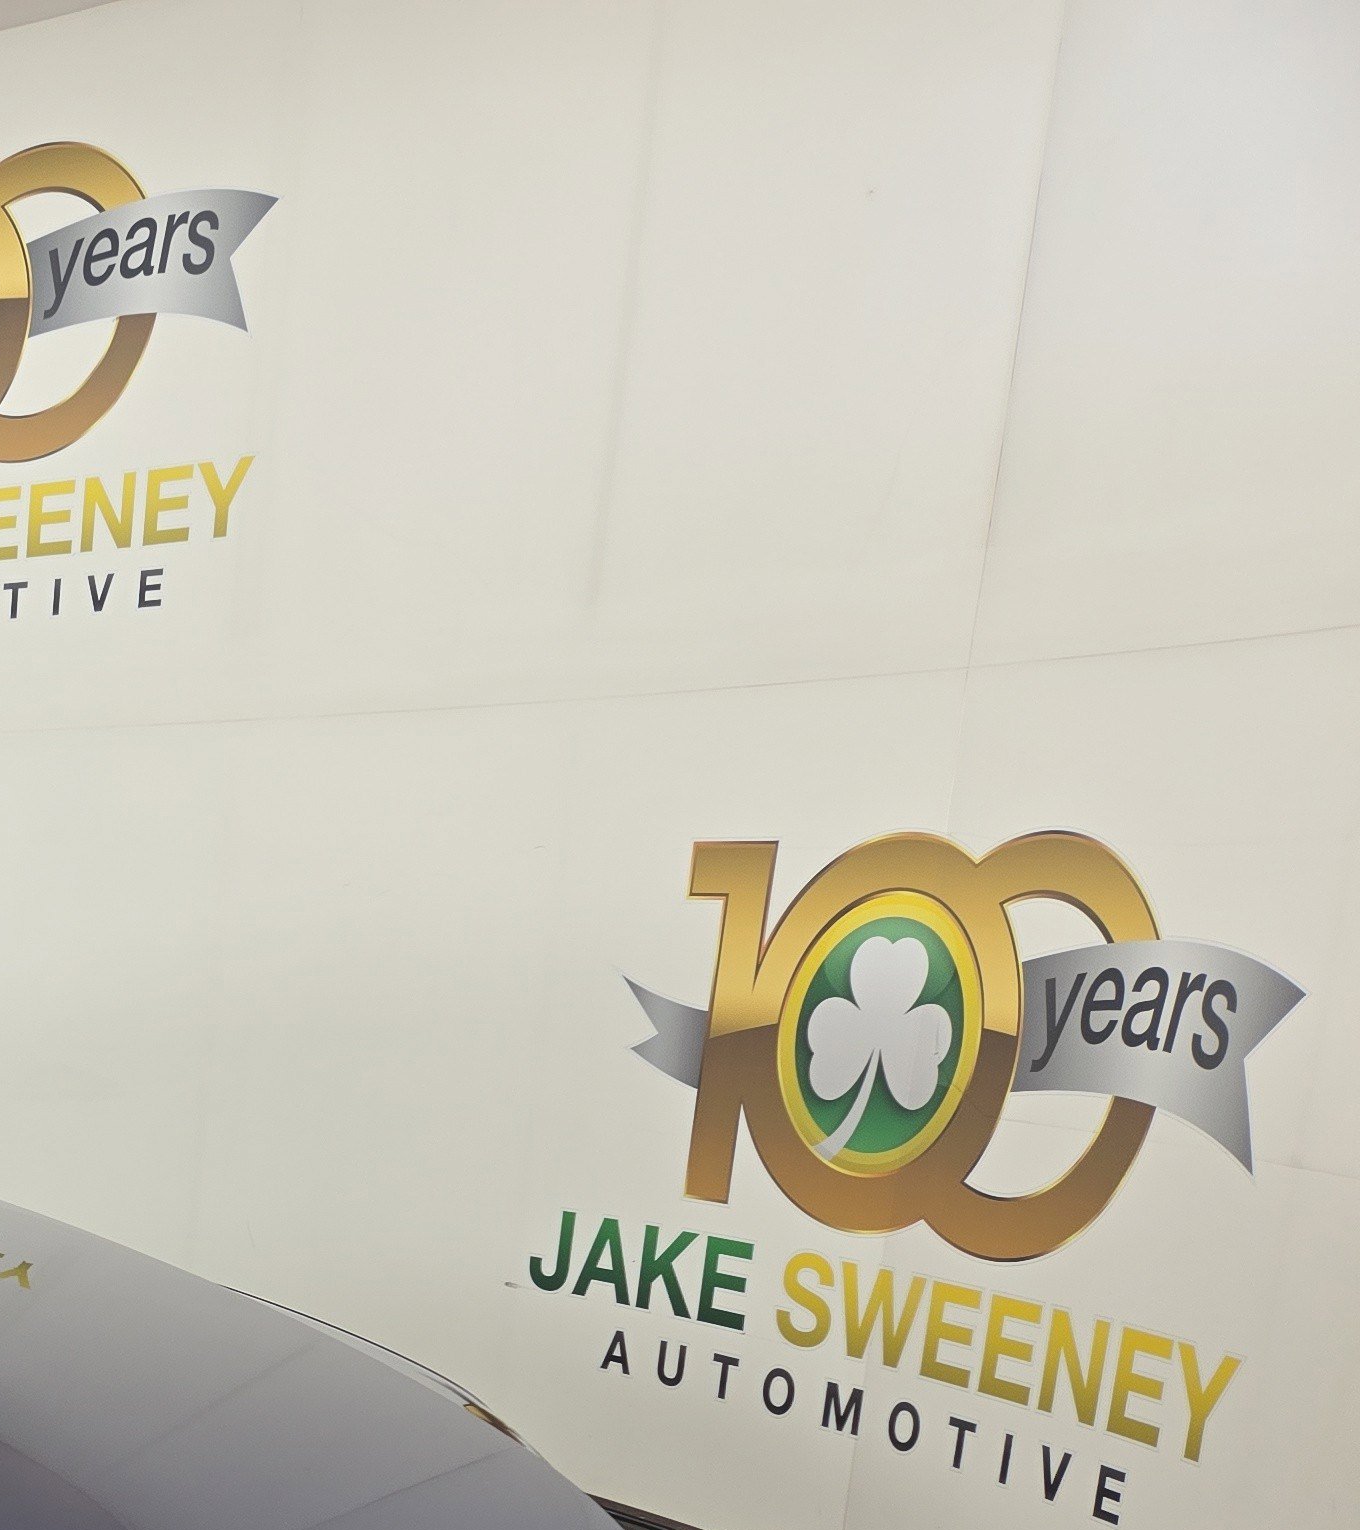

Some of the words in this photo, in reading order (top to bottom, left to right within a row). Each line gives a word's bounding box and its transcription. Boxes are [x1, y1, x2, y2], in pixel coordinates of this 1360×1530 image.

[42, 207, 220, 320] years
[1030, 965, 1238, 1073] years
[529, 1210, 755, 1332] JAKE
[775, 1250, 1248, 1462] SWEENEY
[600, 1329, 1127, 1526] AUTOMOTIVE
